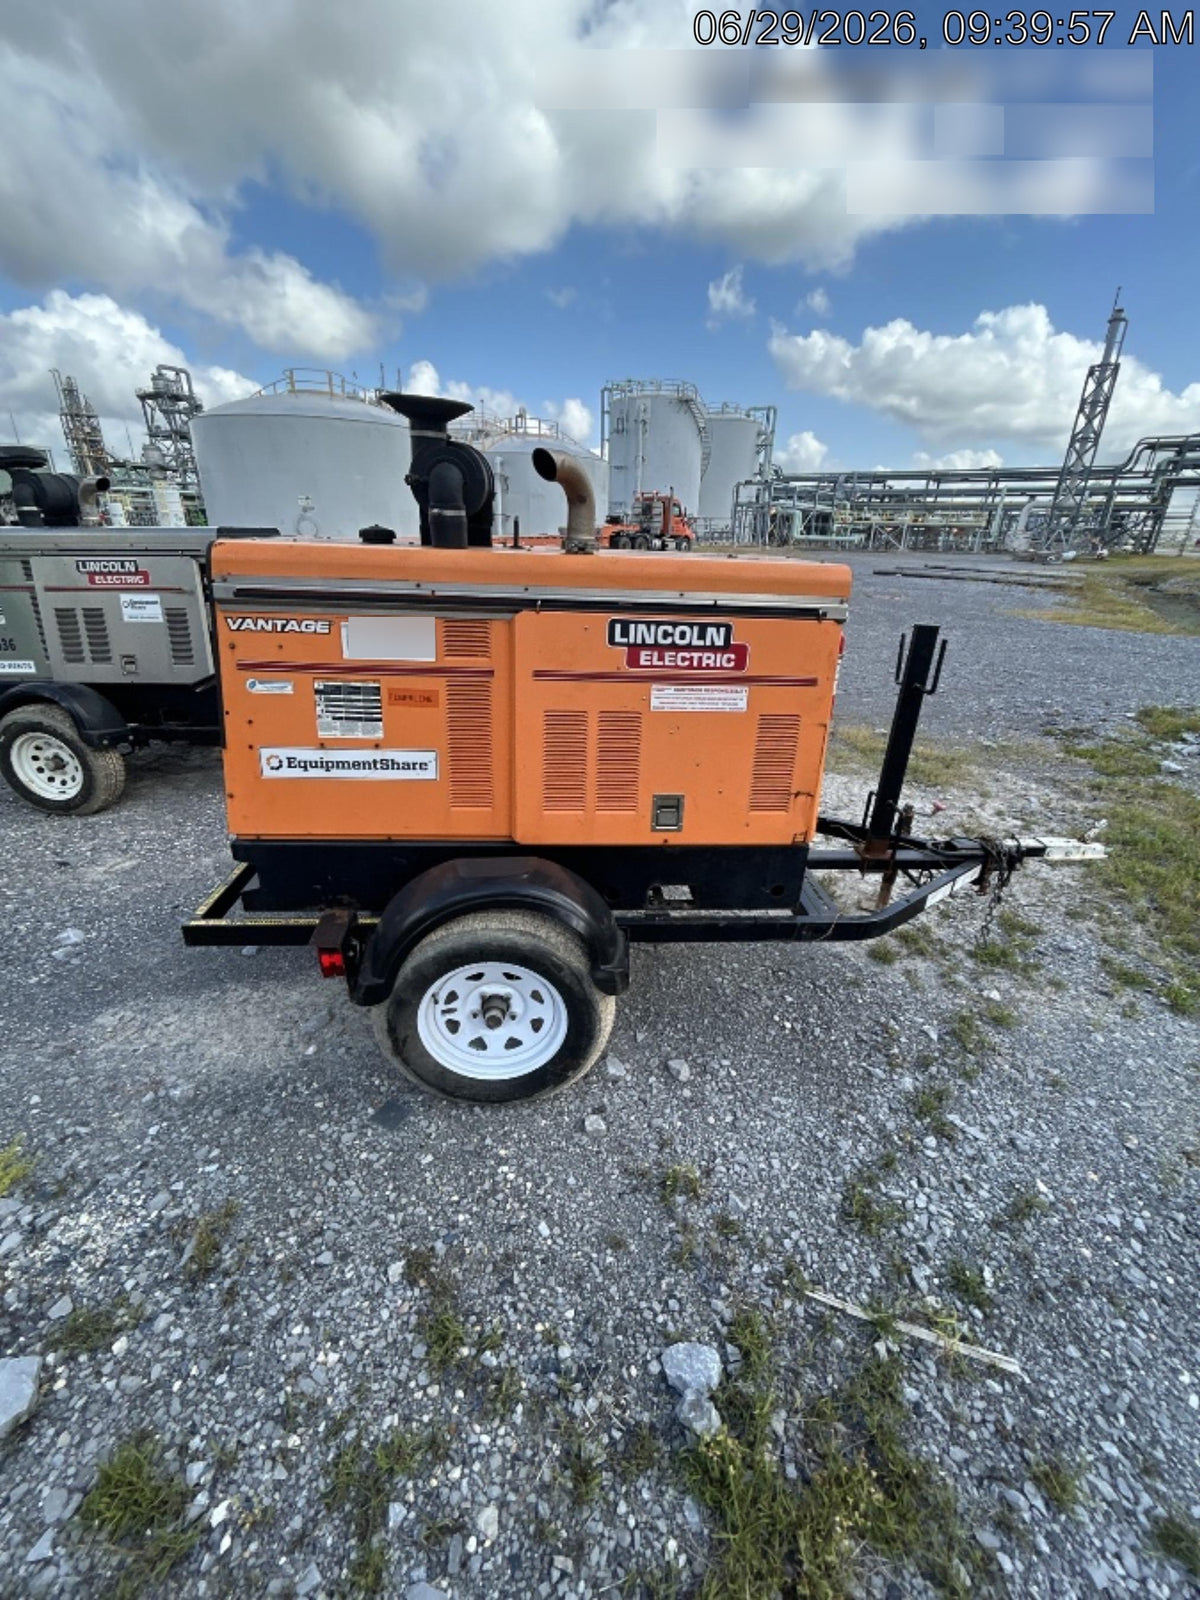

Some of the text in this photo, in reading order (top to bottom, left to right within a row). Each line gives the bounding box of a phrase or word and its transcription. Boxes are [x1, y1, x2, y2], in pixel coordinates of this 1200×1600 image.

[78, 561, 136, 572] LINCOLN
[94, 575, 144, 584] ELECTRIC
[226, 617, 330, 634] VANTAGE
[614, 623, 726, 646] LINCOLN
[640, 650, 736, 668] ELECTRIC
[286, 756, 429, 772] EquipmentShare
